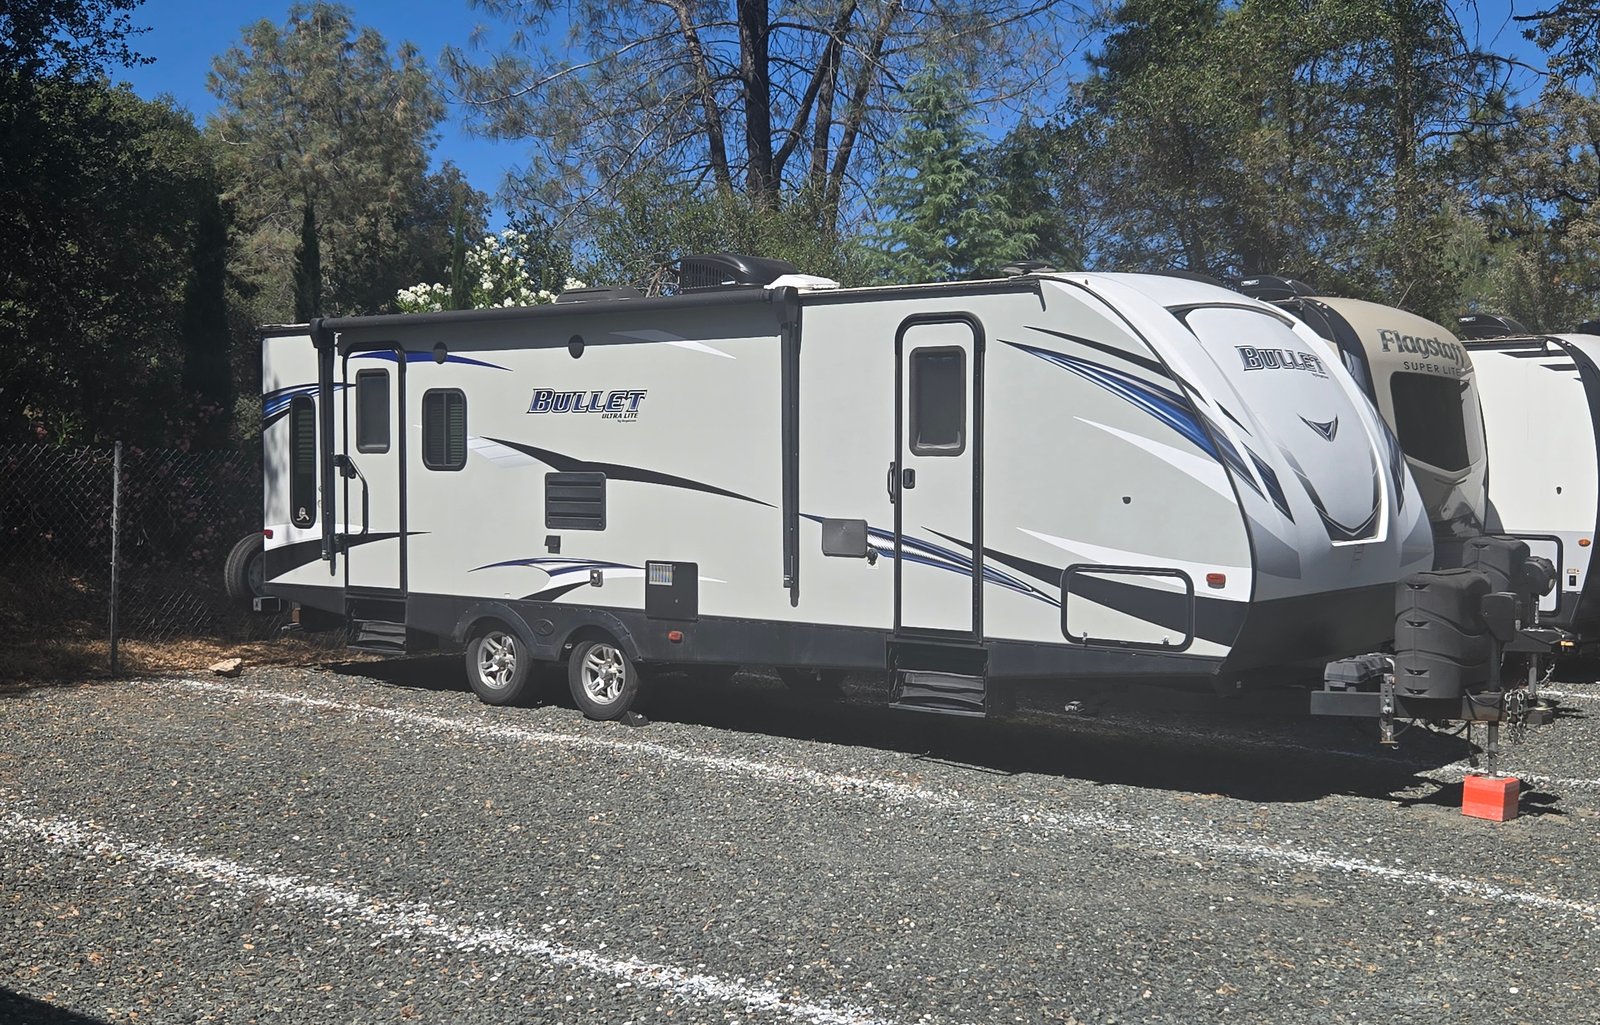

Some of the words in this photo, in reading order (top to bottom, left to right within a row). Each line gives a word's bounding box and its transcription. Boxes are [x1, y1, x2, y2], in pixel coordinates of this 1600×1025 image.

[1234, 345, 1326, 374] BULLET
[1377, 328, 1465, 368] Flagstaff
[1403, 361, 1440, 373] SUPER
[1443, 366, 1462, 377] LITE
[526, 388, 648, 414] BULLET
